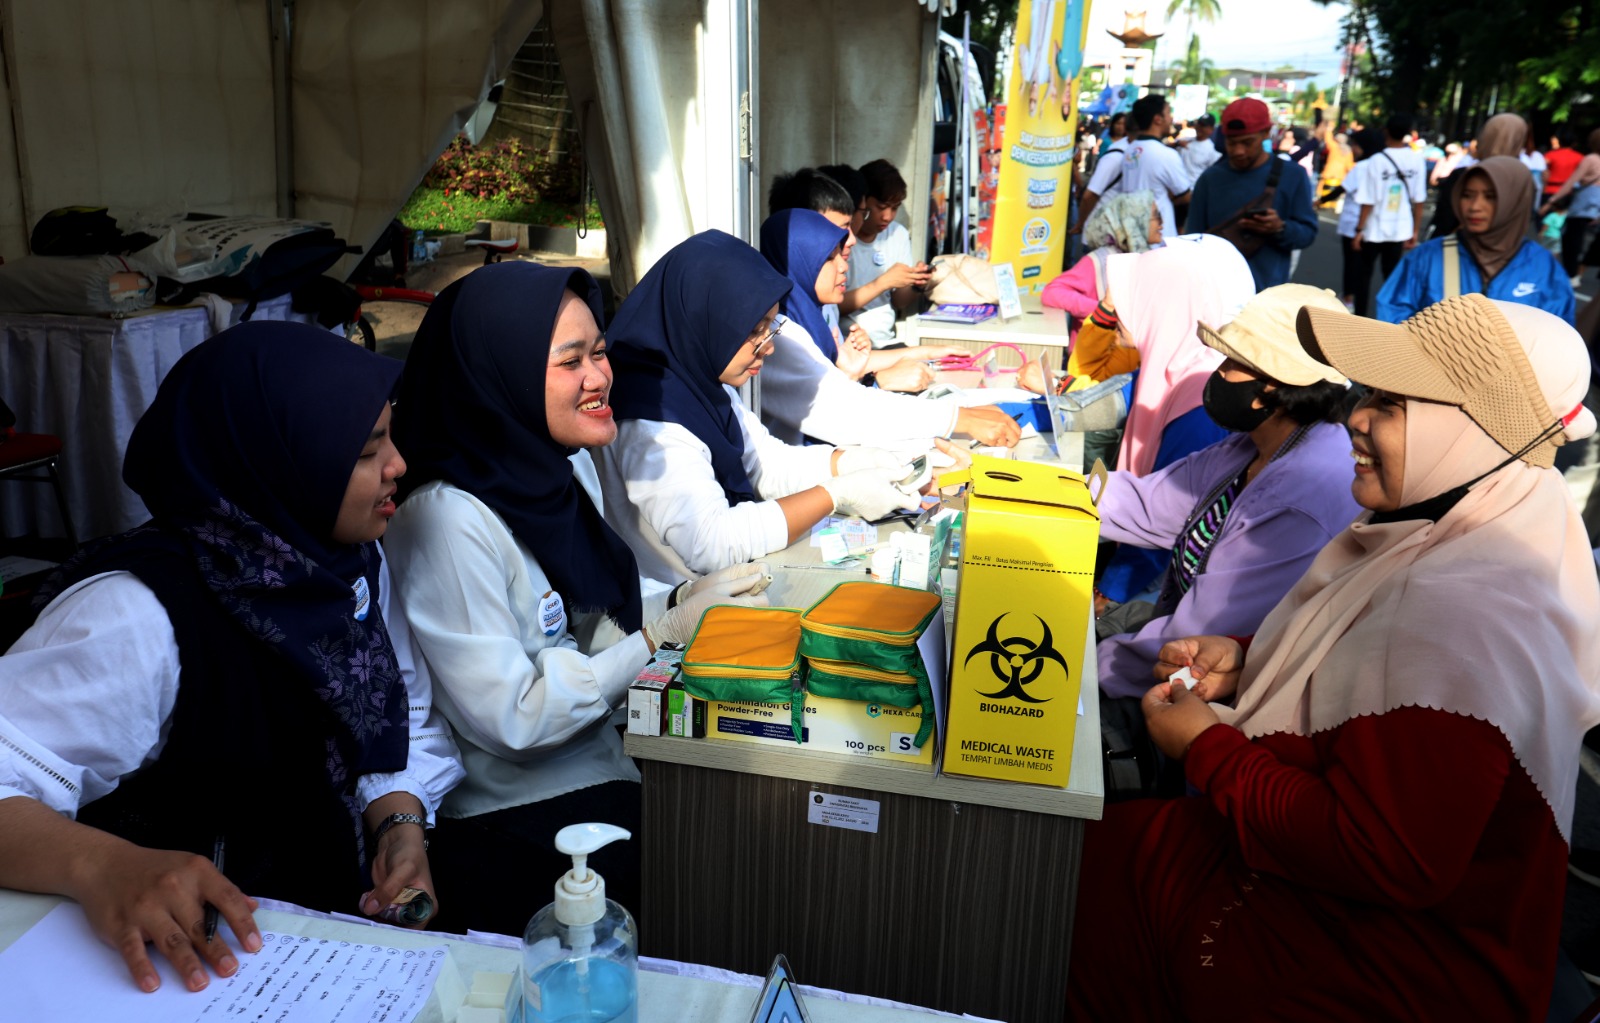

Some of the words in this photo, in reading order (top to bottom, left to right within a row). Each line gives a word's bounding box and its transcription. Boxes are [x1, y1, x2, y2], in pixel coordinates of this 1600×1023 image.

[717, 704, 774, 718] Powder-Free
[883, 709, 903, 717] HEXA
[979, 702, 1045, 718] BIOHAZARD
[845, 740, 864, 750] 100
[899, 736, 911, 750] S
[961, 740, 1013, 755] MEDICAL
[1015, 745, 1055, 760] WASTE
[961, 754, 992, 765] TEMPAT
[994, 757, 1025, 768] LIMBAH
[1026, 761, 1053, 772] MEDIS
